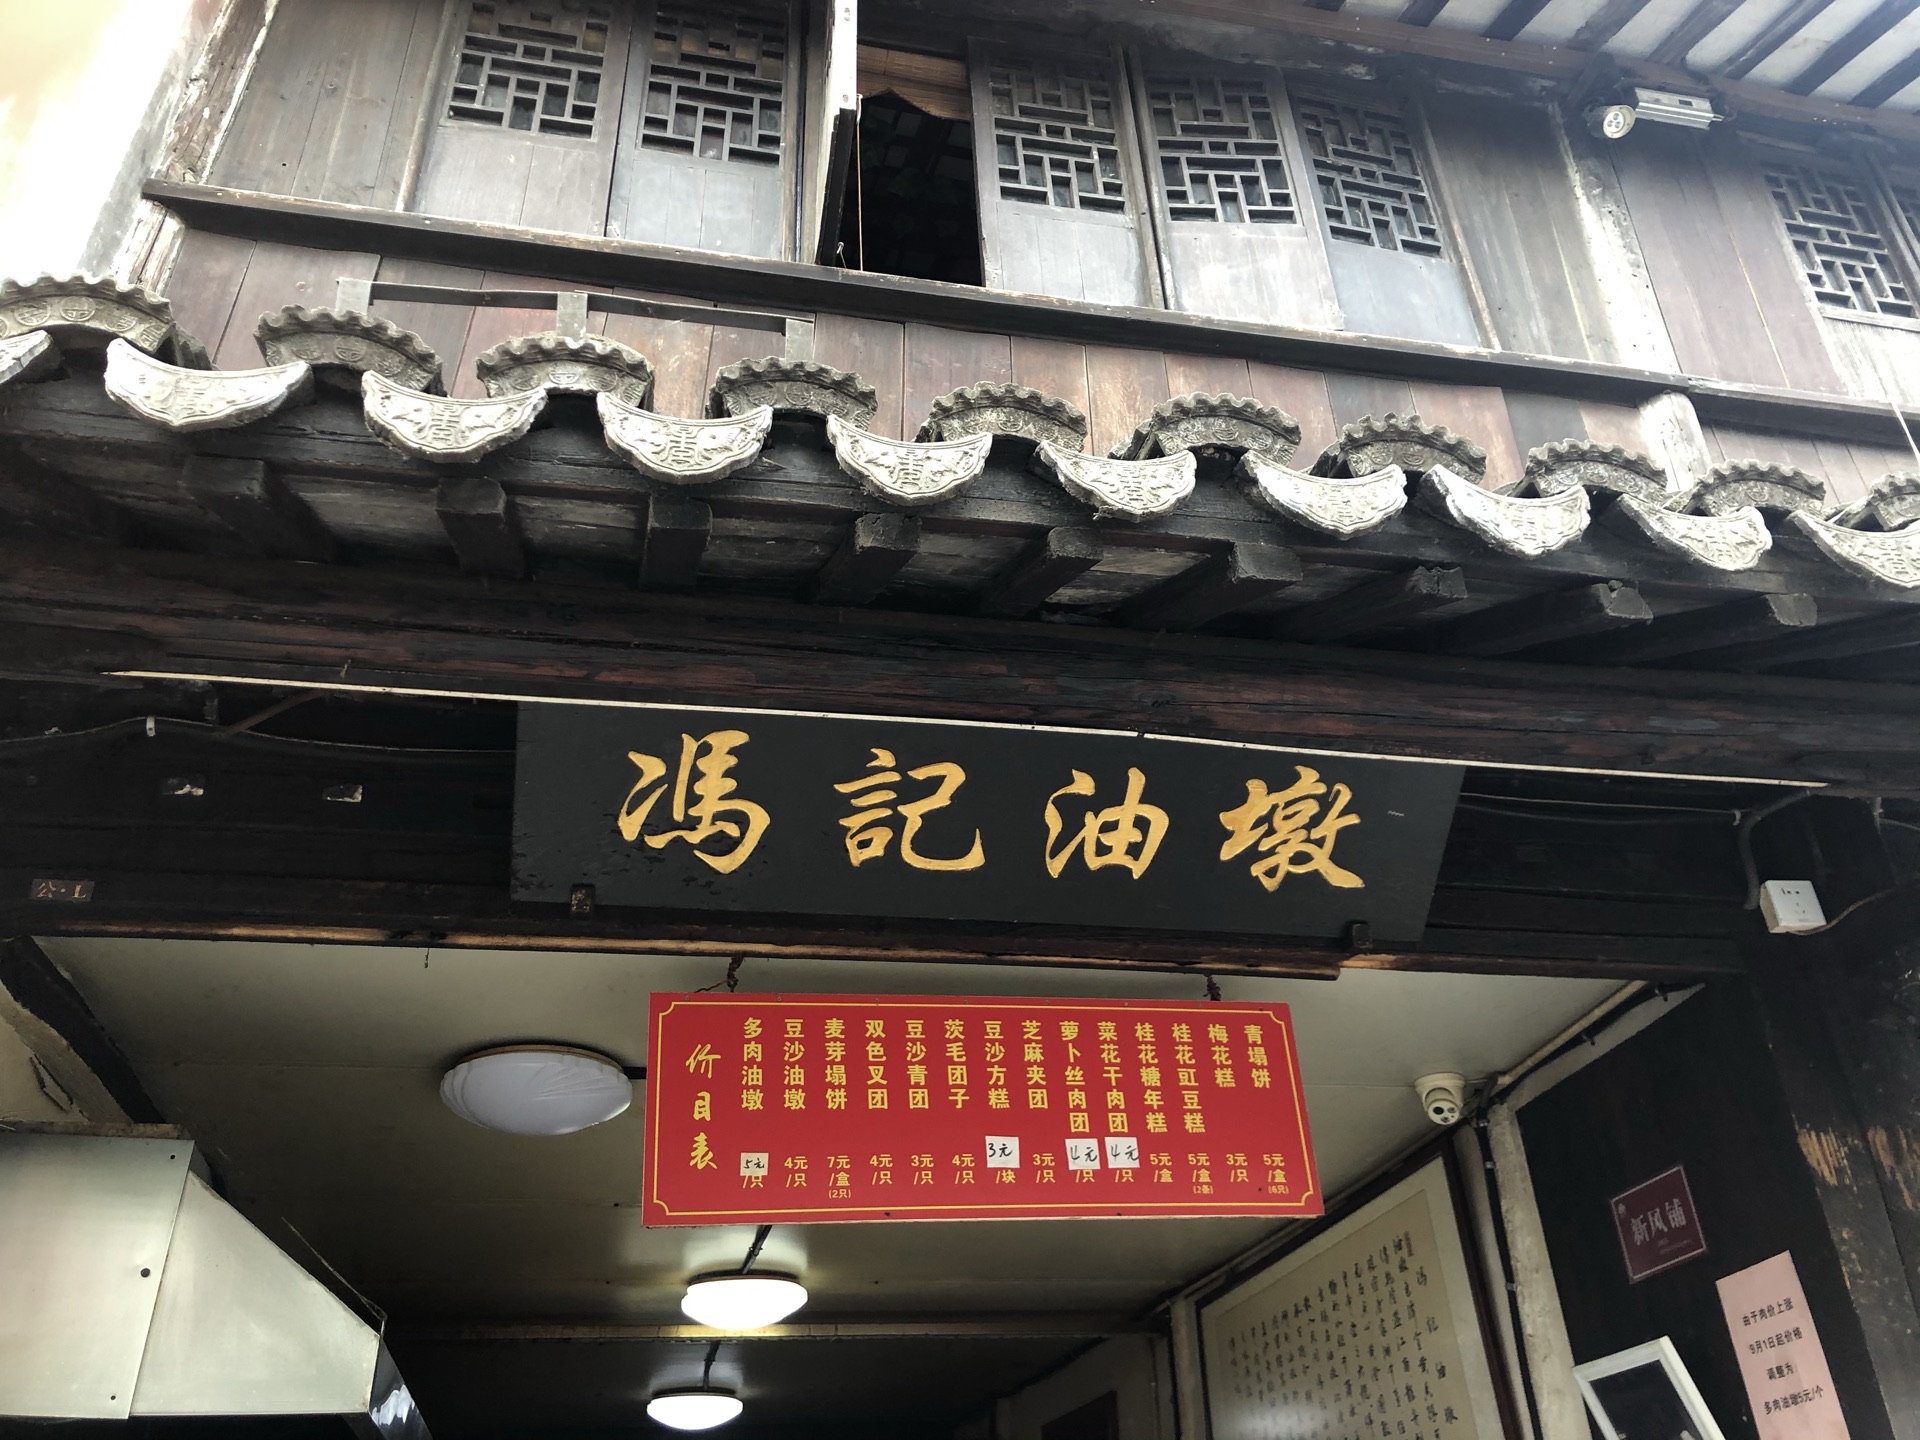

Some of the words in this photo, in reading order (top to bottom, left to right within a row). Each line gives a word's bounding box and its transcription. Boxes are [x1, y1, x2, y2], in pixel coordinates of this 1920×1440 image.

[617, 729, 1364, 892] 馮記油墩
[741, 1016, 764, 1111] 多肉油墩
[783, 1018, 806, 1111] 豆沙油墩
[824, 1017, 848, 1110] 麦芽塌饼
[864, 1019, 889, 1110] 双色叉团
[905, 1019, 929, 1110] 豆沙青团
[943, 1018, 970, 1109] 茨毛团子
[984, 1020, 1010, 1109] 豆沙方糕
[1021, 1019, 1048, 1109] 芝麻夹团
[1059, 1020, 1090, 1133] 萝卜丝肉团
[1097, 1021, 1128, 1133] 菜花干肉团
[1134, 1022, 1168, 1133] 桂花糖年糕
[1171, 1023, 1205, 1133] 桂花豇豆糕
[1208, 1023, 1236, 1088] 梅花糕
[1244, 1024, 1272, 1088] 青塌饼
[685, 1043, 722, 1170] 价目表
[1748, 1326, 1803, 1354] 9月1日起价格
[1766, 1361, 1794, 1380] 调整为
